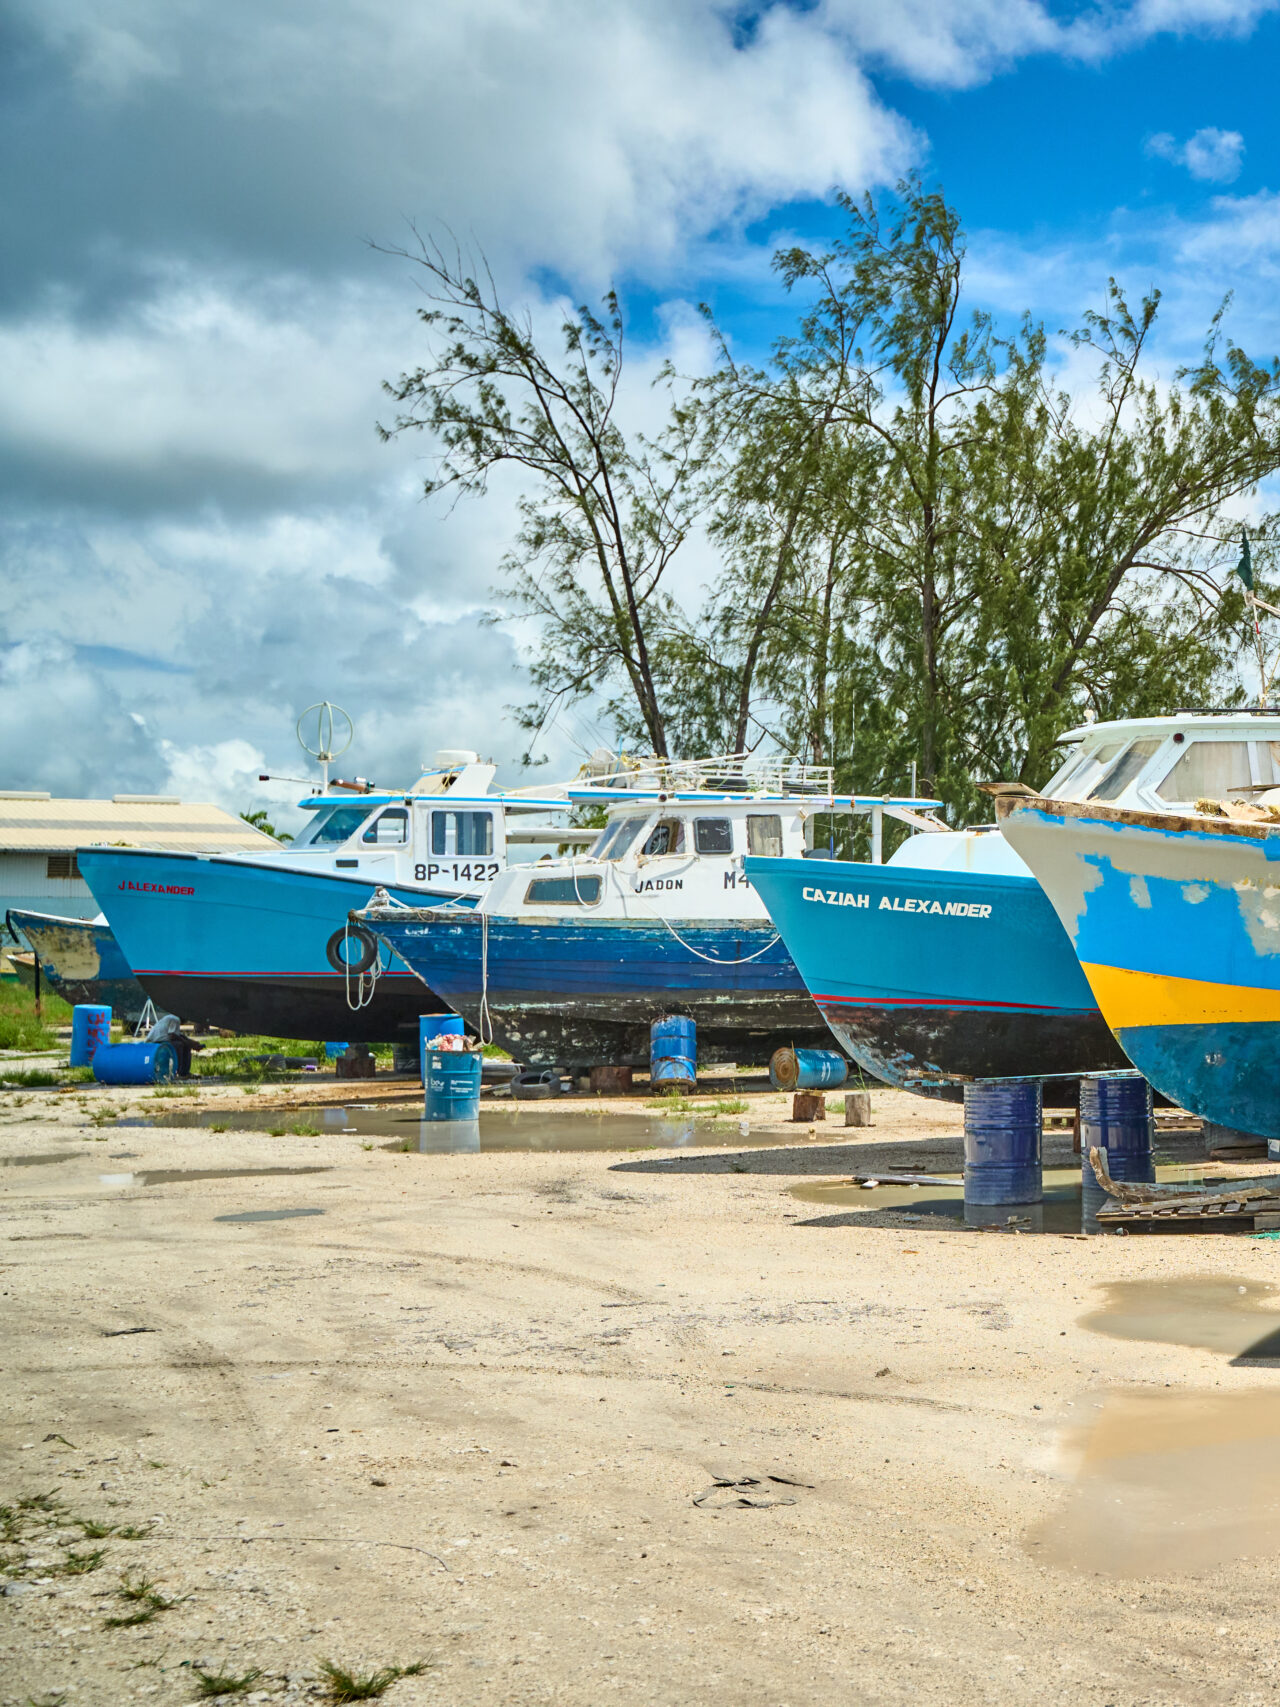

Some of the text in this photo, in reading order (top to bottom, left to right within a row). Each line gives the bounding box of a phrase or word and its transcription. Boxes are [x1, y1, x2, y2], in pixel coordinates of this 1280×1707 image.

[634, 879, 684, 894] JADON
[802, 886, 993, 919] CAZIAH ALEXANDER
